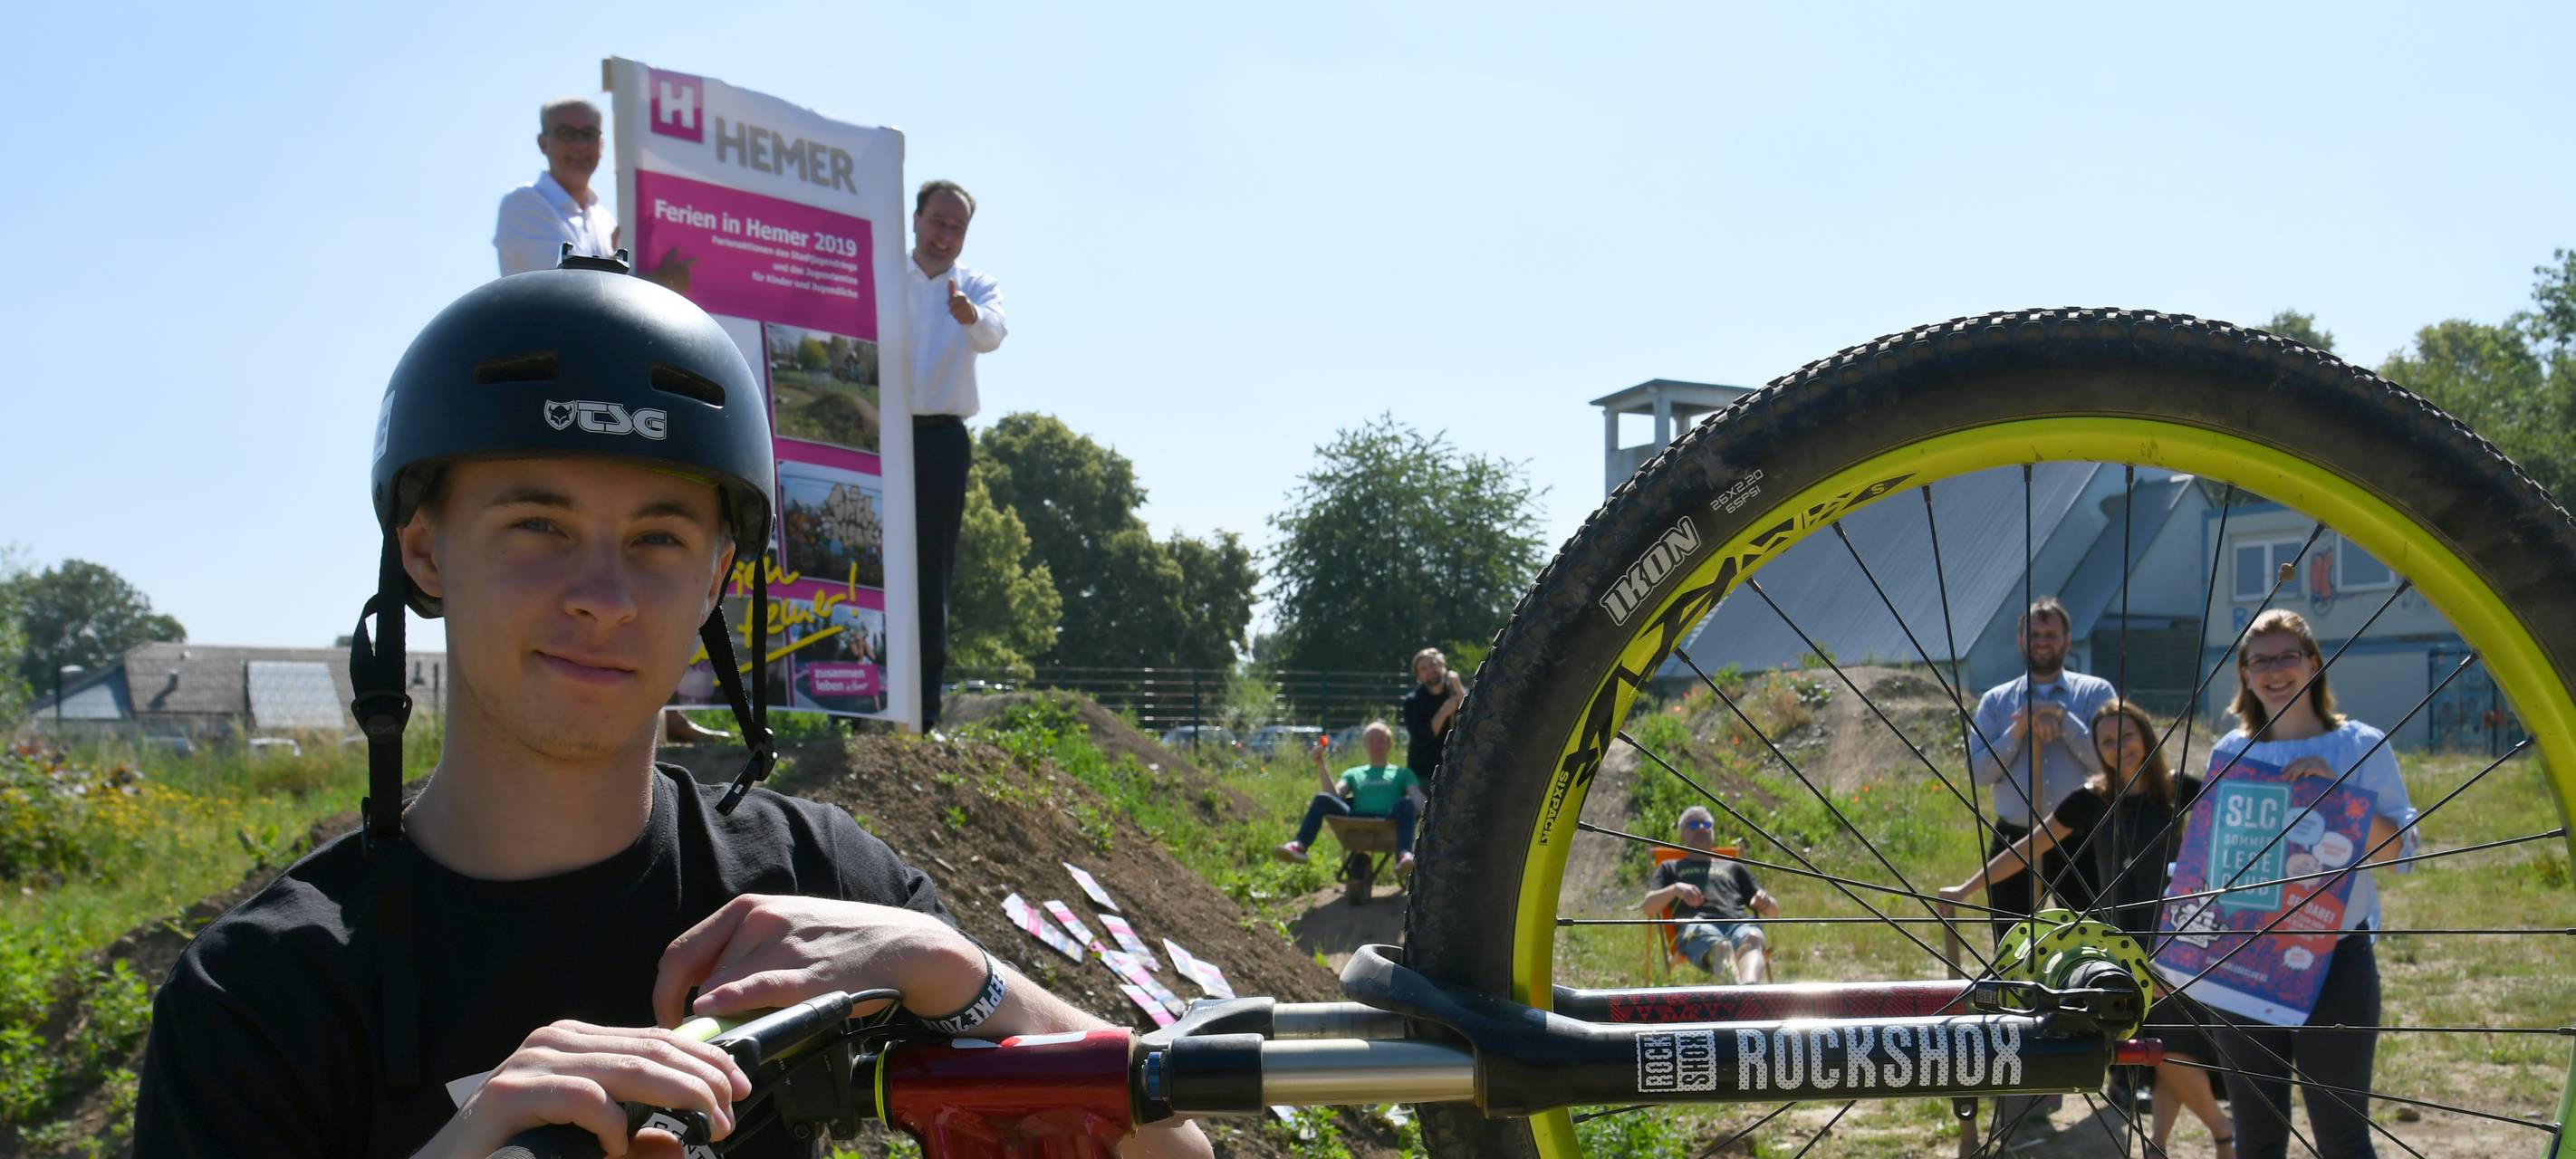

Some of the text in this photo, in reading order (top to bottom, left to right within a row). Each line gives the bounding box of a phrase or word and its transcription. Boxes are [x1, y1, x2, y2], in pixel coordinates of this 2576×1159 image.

[715, 117, 858, 195] HEMER
[654, 198, 857, 257] Ferien in Hemer 2019
[766, 273, 793, 286] Kinder
[812, 283, 858, 299] Jugendliche
[576, 400, 667, 440] TSG
[1710, 469, 1764, 511] 26X2.20
[1725, 485, 1761, 513] 65PSI
[1600, 516, 1701, 626] IKON
[815, 680, 843, 691] leben
[1541, 771, 1569, 846] SIXPACK
[2225, 794, 2278, 829] SLC
[1644, 1036, 1674, 1087] ROCK
[1681, 1036, 1710, 1086] SHOX
[1736, 1024, 2022, 1090] ROCKSHOX
